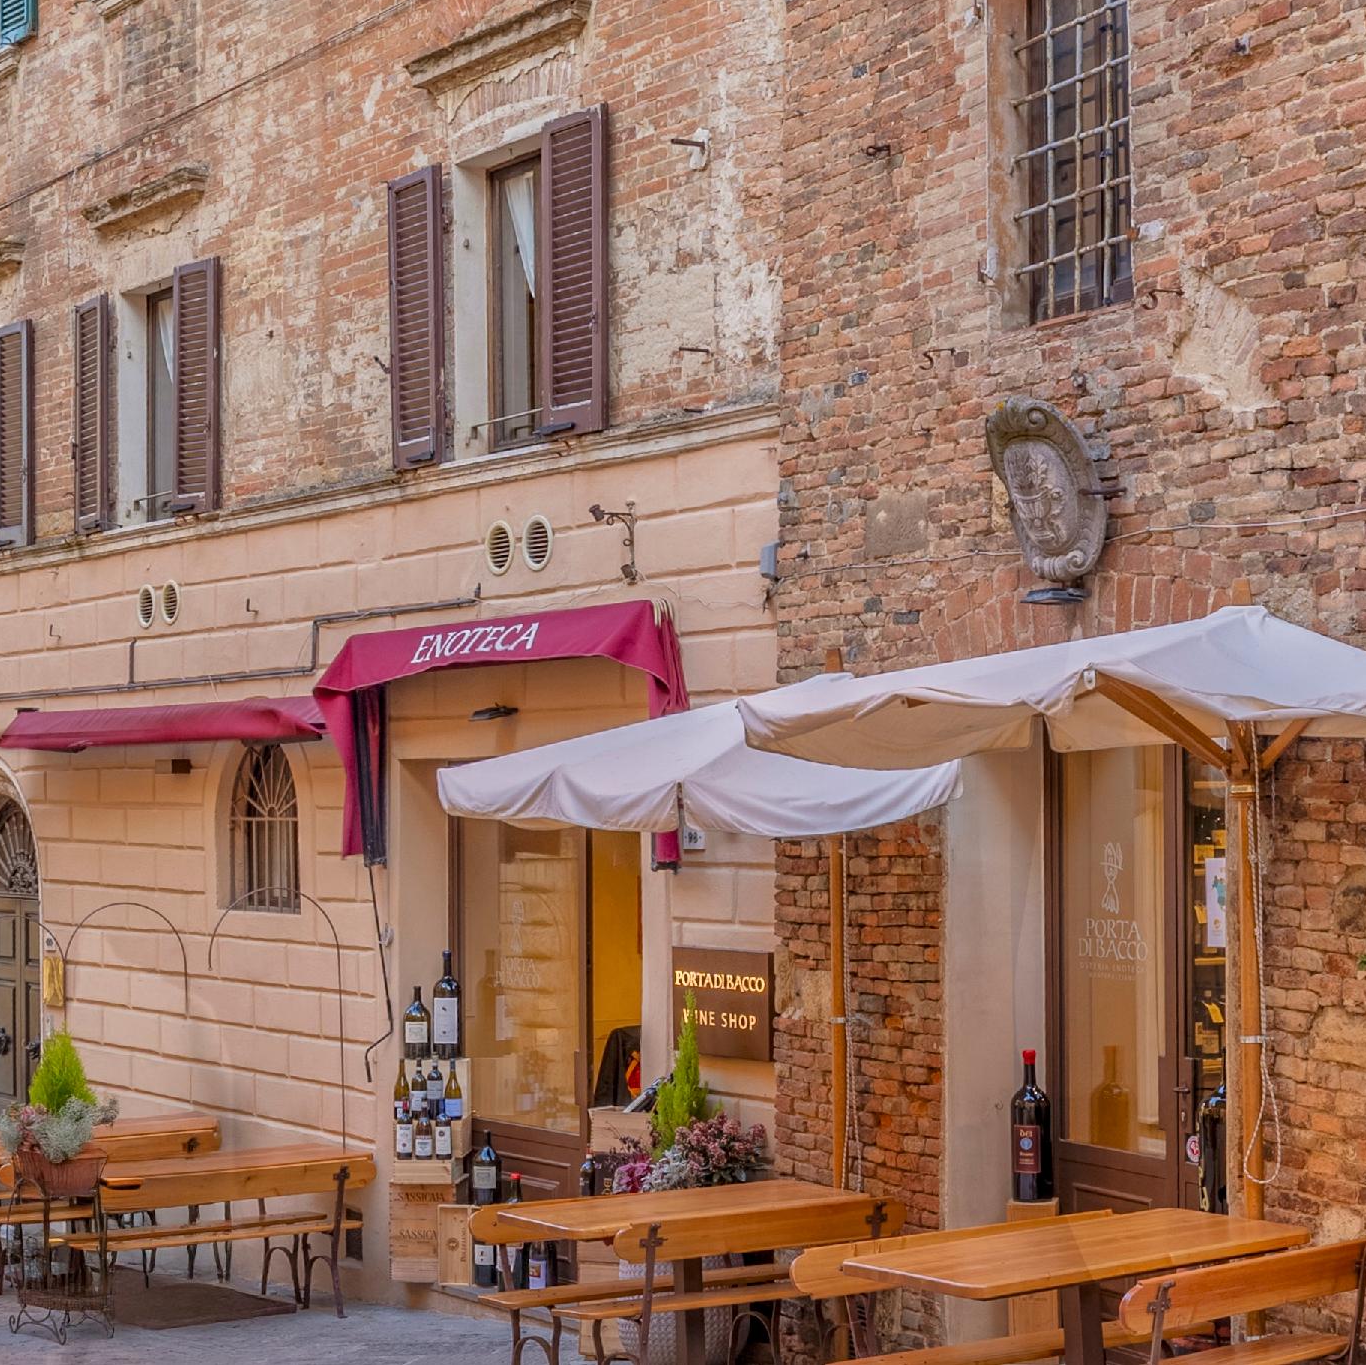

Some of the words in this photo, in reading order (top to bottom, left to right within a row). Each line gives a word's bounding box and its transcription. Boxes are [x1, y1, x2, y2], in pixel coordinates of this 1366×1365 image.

[410, 622, 539, 664] ENOTECA
[1086, 918, 1141, 941] PORTA
[1078, 938, 1092, 957] DI
[1096, 938, 1148, 962] BACCO
[721, 1012, 757, 1031] SHOP
